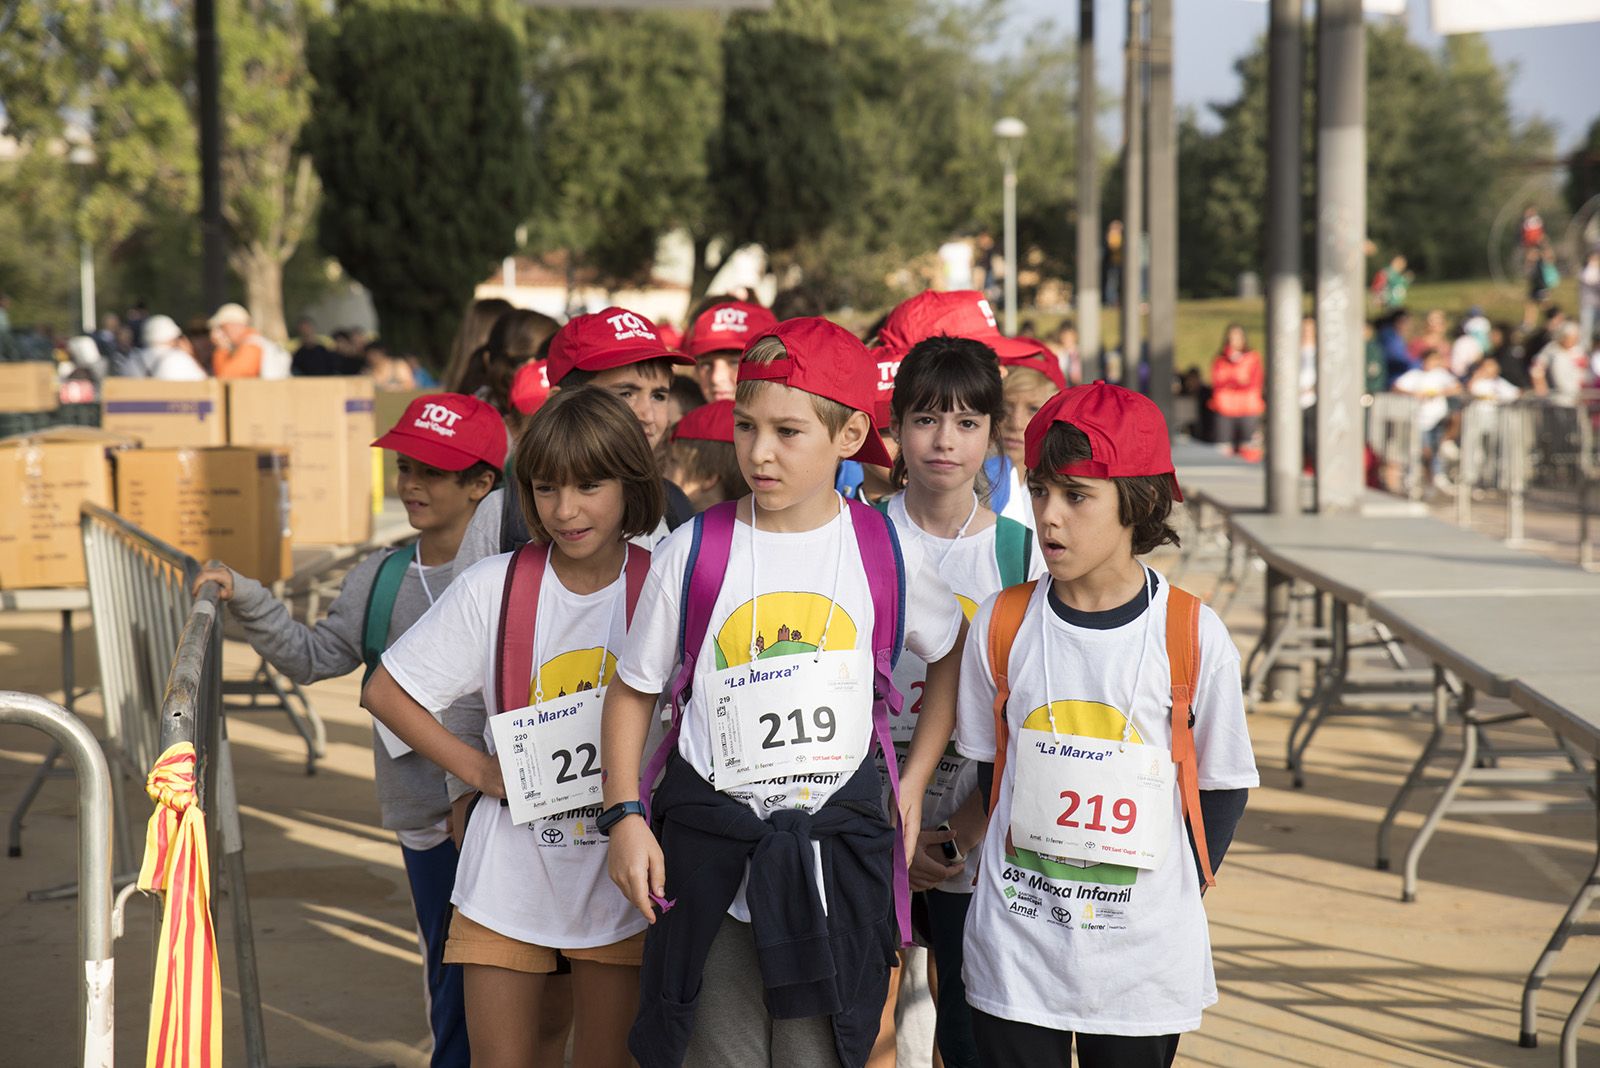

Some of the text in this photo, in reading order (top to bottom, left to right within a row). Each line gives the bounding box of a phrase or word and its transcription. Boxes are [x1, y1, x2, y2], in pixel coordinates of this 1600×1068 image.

[421, 403, 462, 427] TOT
[719, 695, 731, 705] 219
[513, 733, 528, 741] 220
[759, 706, 837, 749] 219
[551, 742, 602, 785] 22
[1056, 790, 1137, 835] 219
[1028, 875, 1073, 899] Marxa
[1076, 885, 1132, 903] Infantil
[1087, 922, 1106, 930] ferrer
